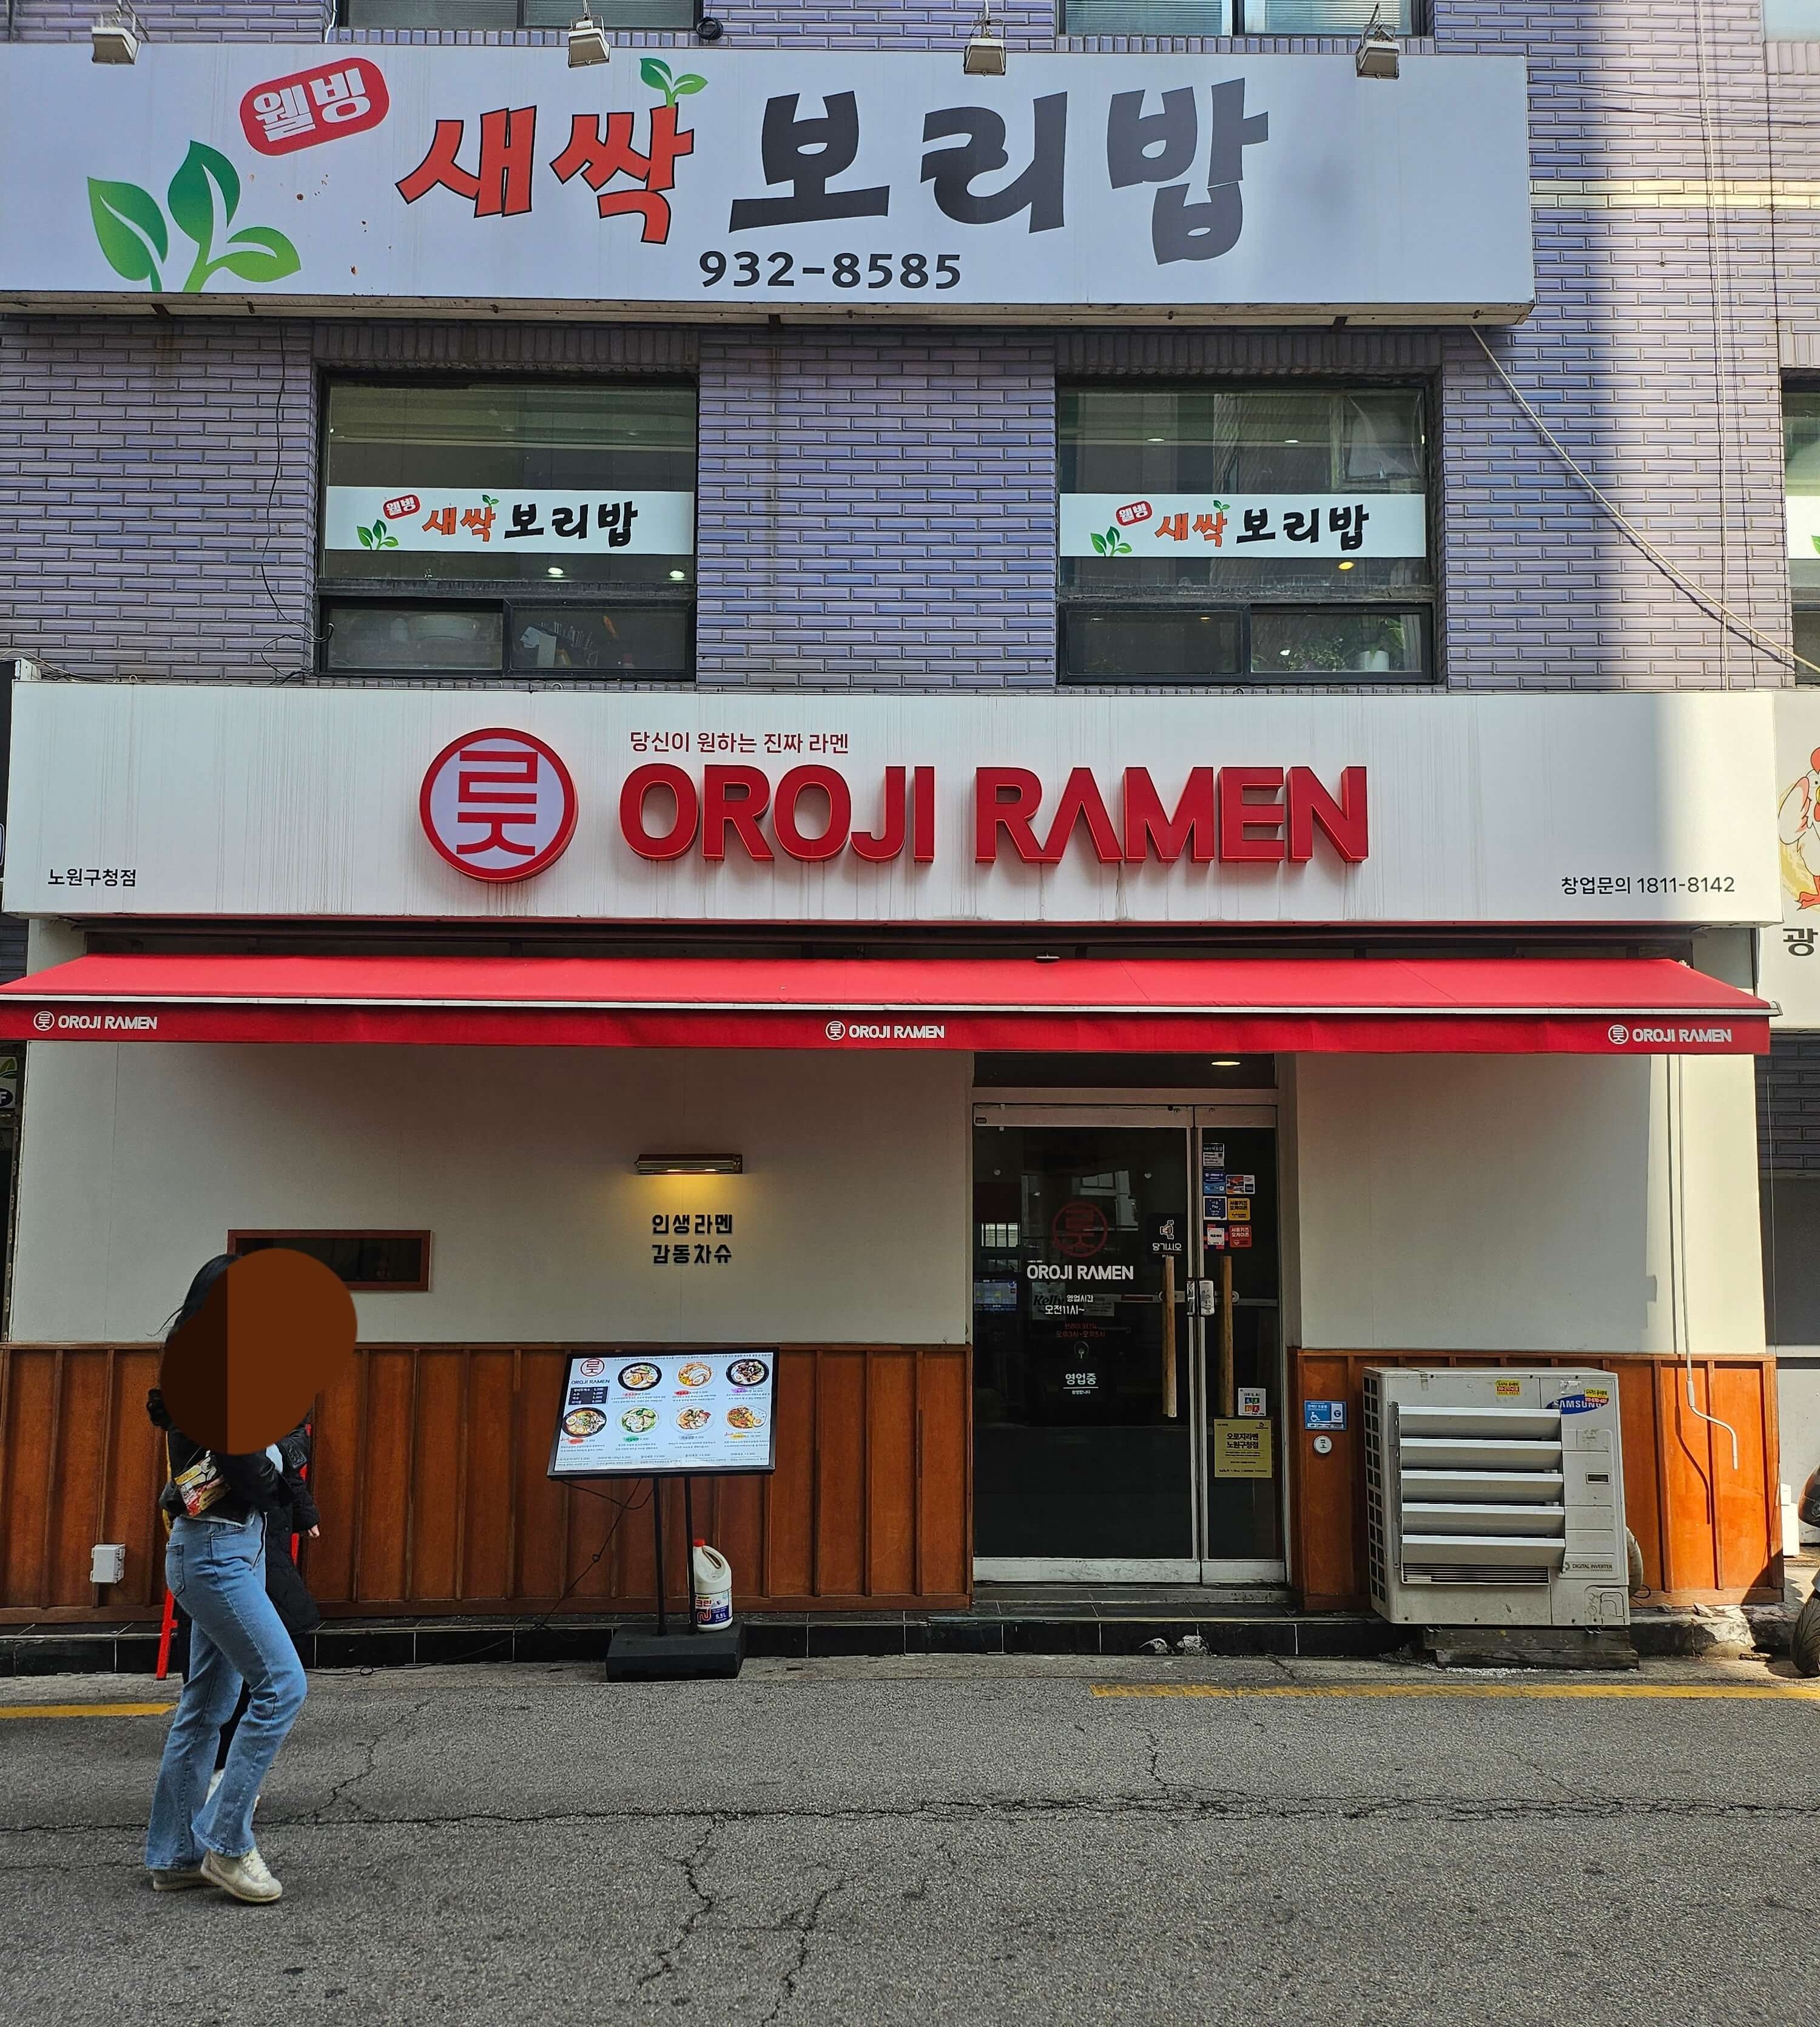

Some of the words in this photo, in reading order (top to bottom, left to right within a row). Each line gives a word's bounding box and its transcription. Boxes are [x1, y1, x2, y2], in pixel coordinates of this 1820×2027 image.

[252, 66, 372, 144] 웰빙
[394, 104, 695, 245] 새싹
[728, 77, 1269, 266] 보리밥
[699, 249, 962, 291] 932-8585
[385, 496, 416, 517] 웰빙
[1118, 502, 1148, 523] 웰빙
[421, 506, 496, 542] 새싹
[504, 500, 638, 548] 보리밥
[1154, 511, 1228, 547] 새싹
[1235, 504, 1370, 551] 보리밥
[630, 731, 690, 753] 당신이
[697, 732, 758, 754] 원하는
[763, 732, 804, 754] 진짜
[809, 733, 849, 755] 라멘
[618, 763, 935, 863] OROJI
[974, 765, 1369, 863] RAMEN
[47, 868, 137, 888] 노원구청점
[1561, 876, 1632, 895] 창업문의
[1637, 876, 1736, 894] 1811-8142
[1782, 928, 1819, 957] 광
[58, 1016, 101, 1030] OROJI
[104, 1016, 158, 1030] RAMEN
[849, 1025, 891, 1039] OROJI
[894, 1025, 945, 1039] RAMEN
[1632, 1028, 1676, 1043] OROJI
[1679, 1028, 1732, 1044] RAMEN
[652, 1214, 733, 1234] 인생라멘
[652, 1244, 732, 1264] 감동차슈
[1153, 1243, 1182, 1251] 당기시오
[1026, 1264, 1073, 1280] OROJI
[1077, 1265, 1134, 1280] RAMEN
[1065, 1372, 1097, 1385] 영업중
